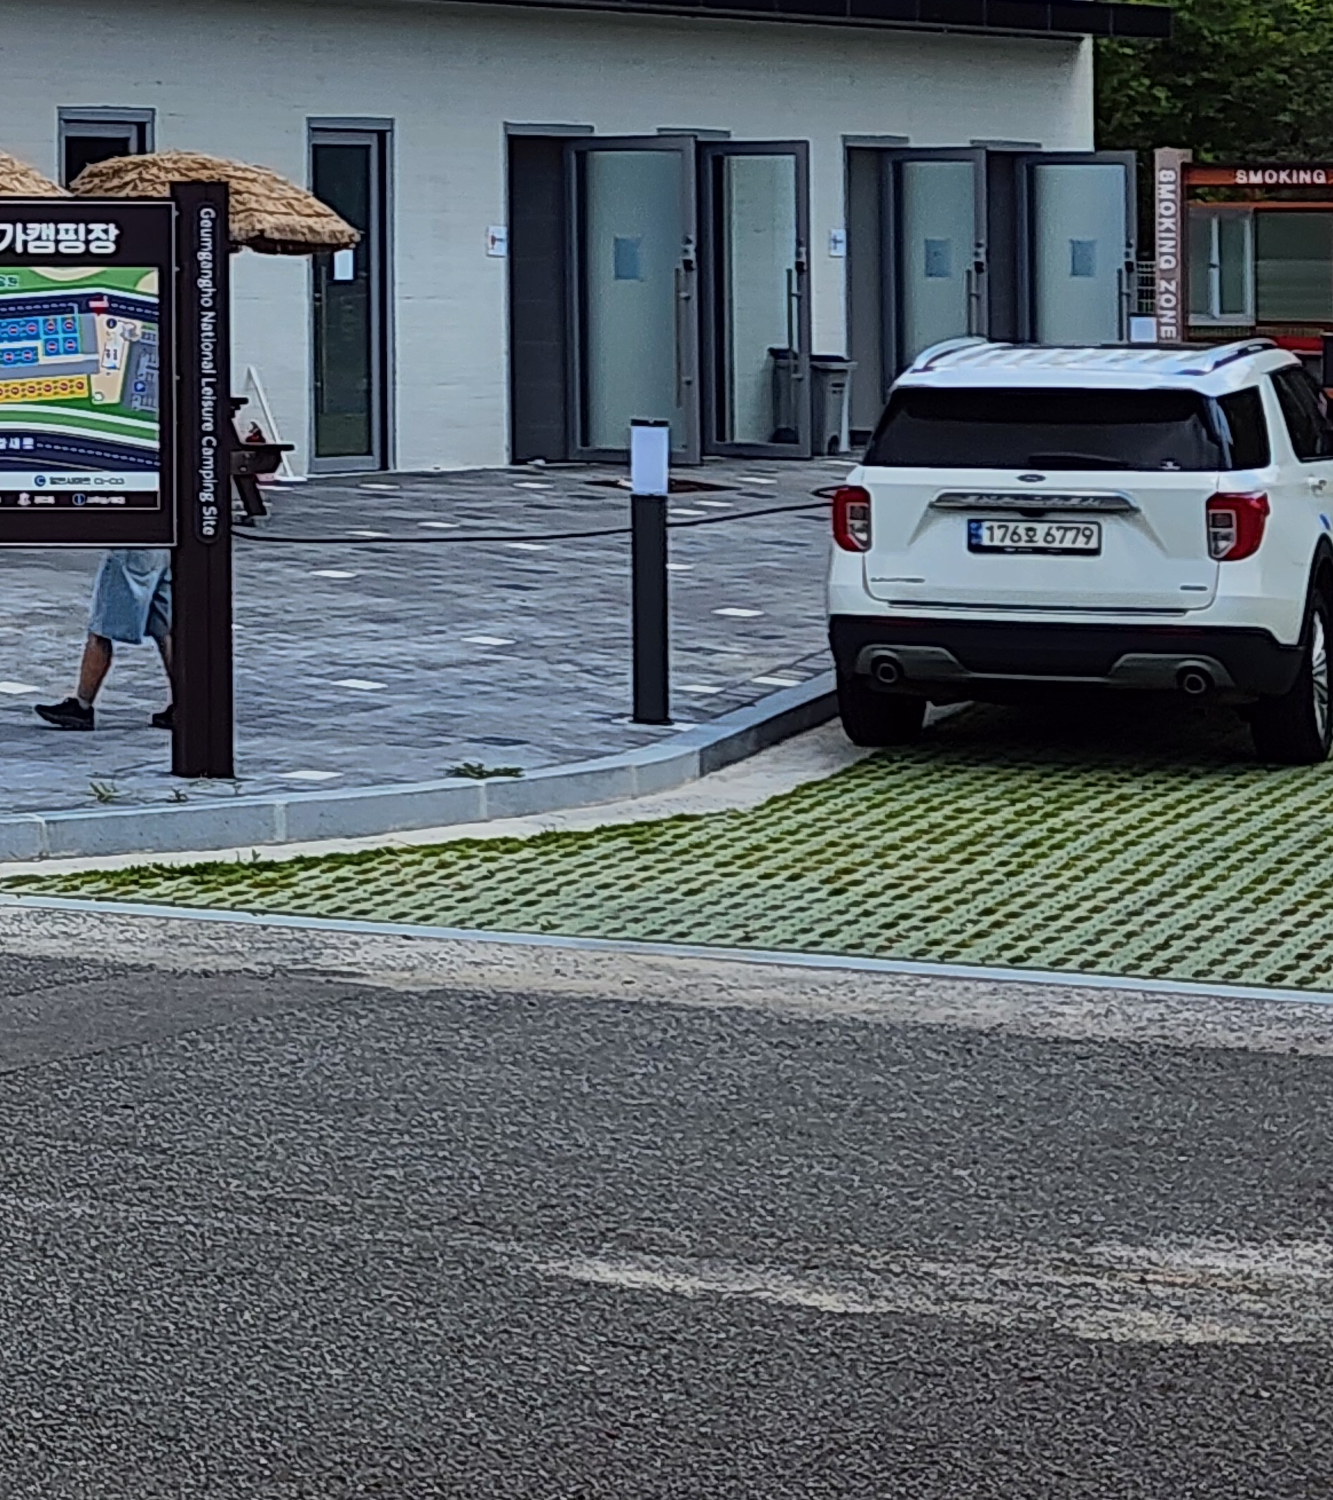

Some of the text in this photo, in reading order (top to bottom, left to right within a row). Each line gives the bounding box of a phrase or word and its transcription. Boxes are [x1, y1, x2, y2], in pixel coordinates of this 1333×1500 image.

[1235, 169, 1326, 184] SMOKING
[1158, 170, 1176, 339] SMOKING ZONE
[197, 208, 219, 536] Geumgangho National Leisure Camping Site
[985, 524, 1094, 545] 176호 6779
